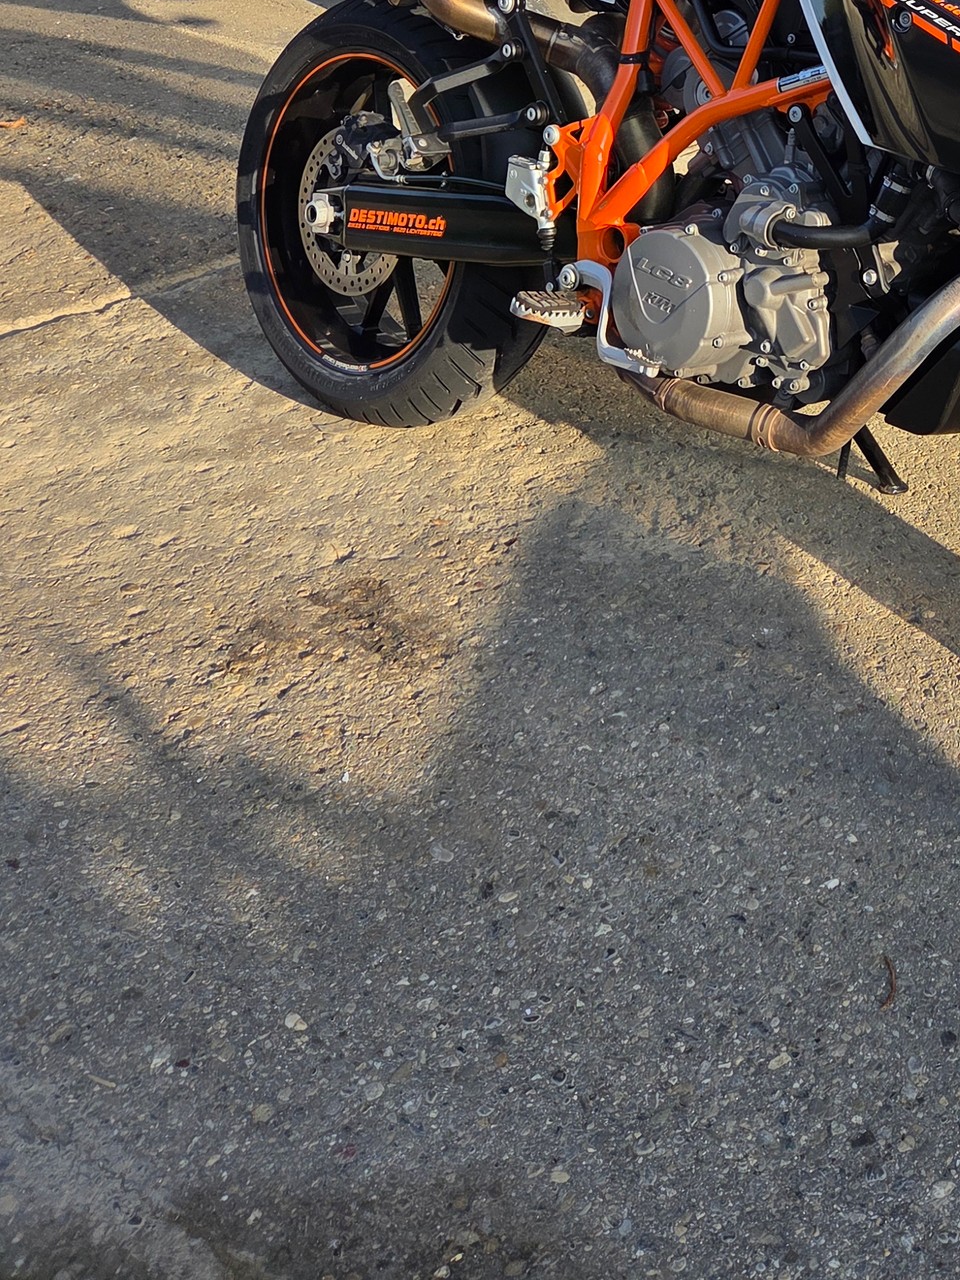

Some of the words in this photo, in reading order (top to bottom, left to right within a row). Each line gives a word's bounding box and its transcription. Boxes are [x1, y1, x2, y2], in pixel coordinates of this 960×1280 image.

[350, 208, 446, 230] DESTIMOTO.ch
[636, 257, 693, 291] LC8
[642, 291, 676, 314] KTM
